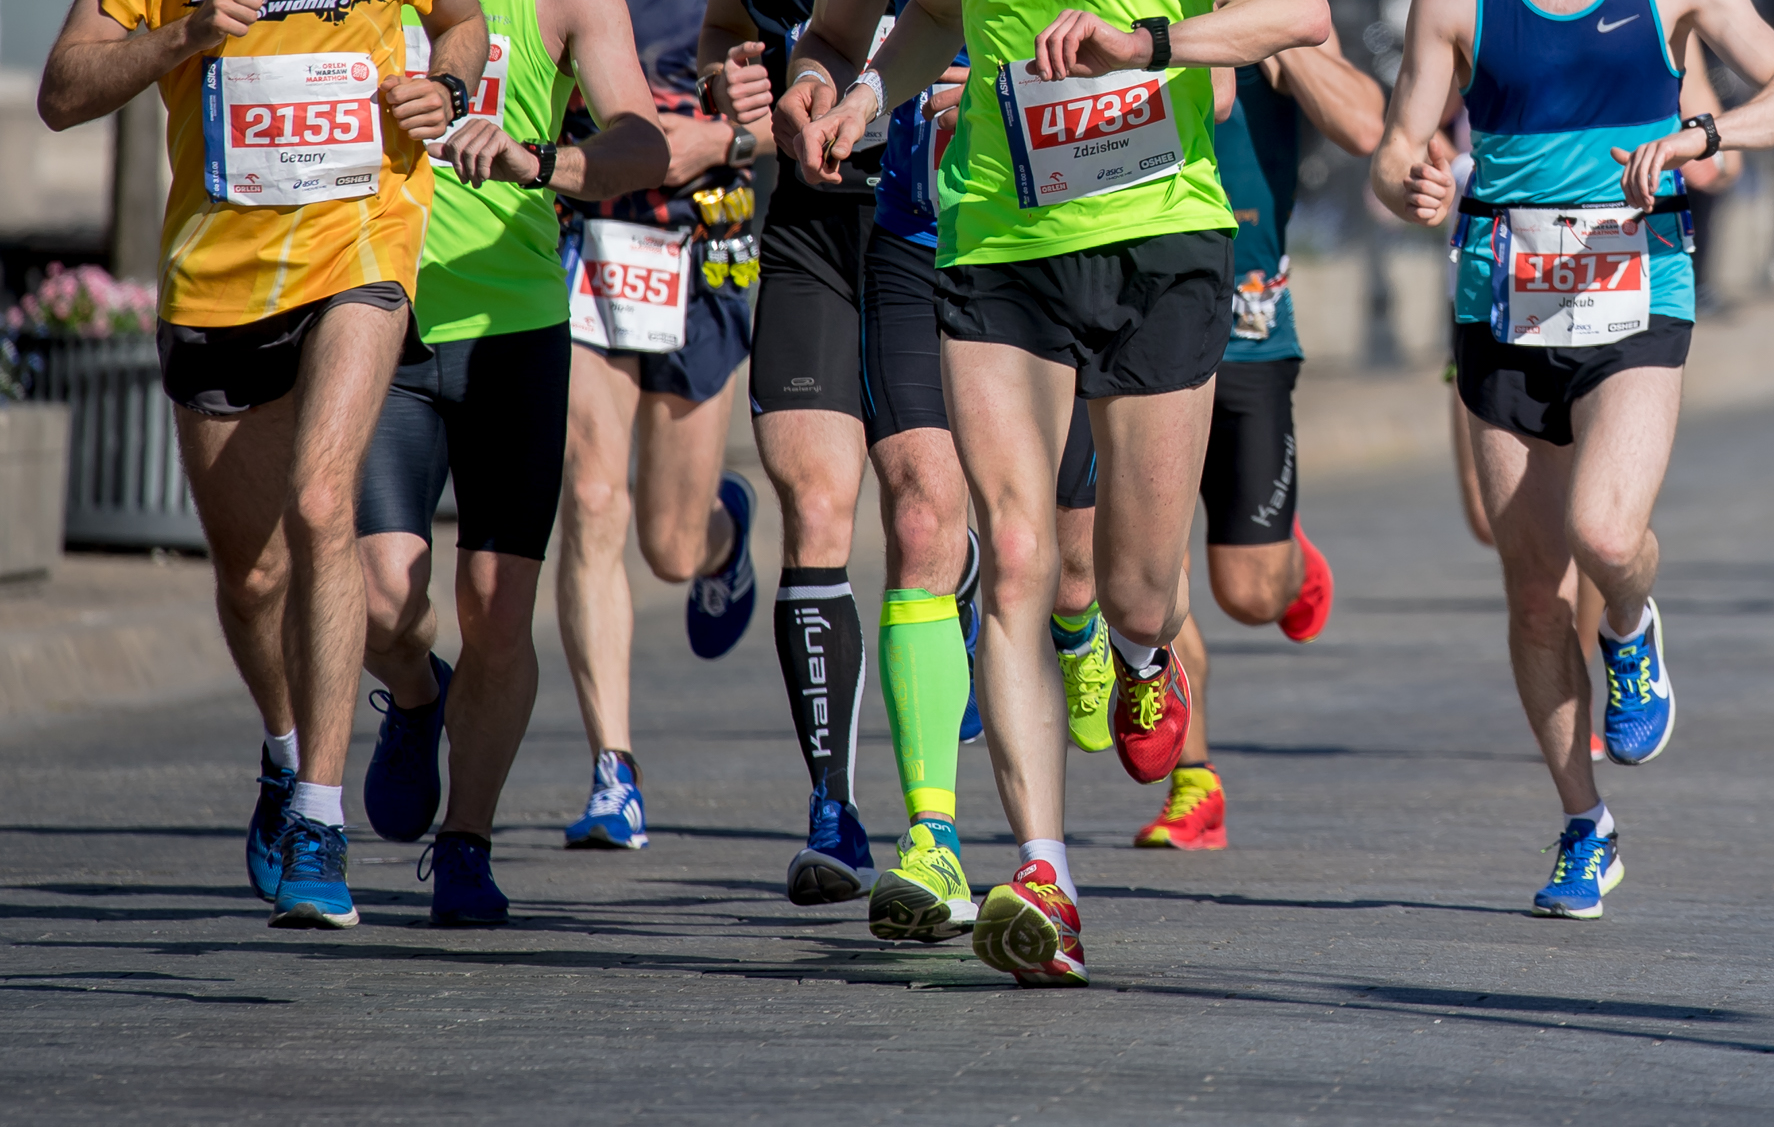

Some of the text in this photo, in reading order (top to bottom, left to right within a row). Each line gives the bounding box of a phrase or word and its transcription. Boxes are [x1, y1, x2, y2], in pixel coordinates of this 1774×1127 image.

[314, 68, 348, 76] WARSAW
[305, 75, 348, 83] MARATHON
[1040, 86, 1151, 143] 4733
[244, 102, 360, 145] 2155
[1073, 137, 1130, 159] Zdzisław
[280, 151, 326, 164] Cezary
[1140, 153, 1174, 169] OSHEE
[337, 175, 370, 185] OSHEE
[235, 185, 261, 193] ORLEN
[1041, 183, 1067, 193] ORLEN
[1526, 255, 1631, 291] 1617
[1558, 296, 1595, 308] Jakub
